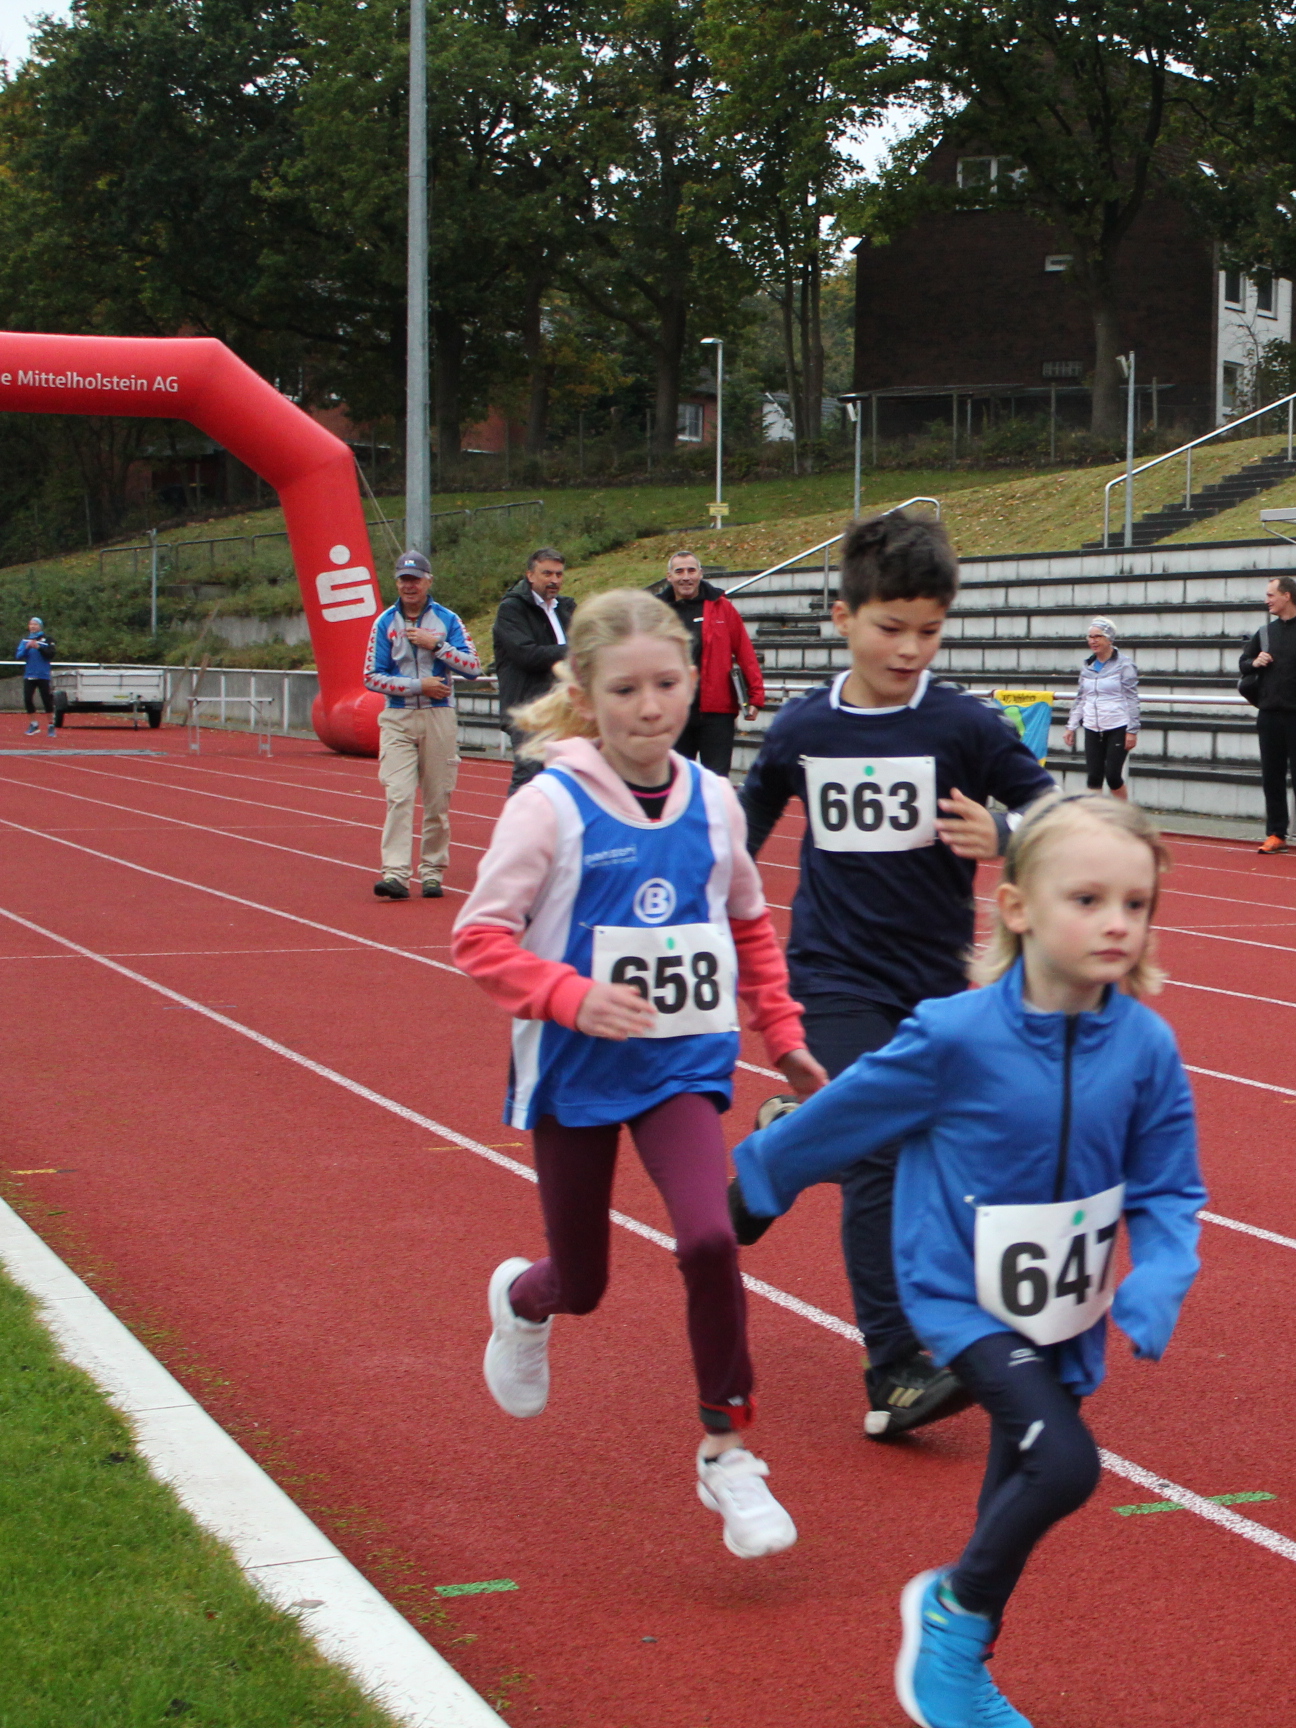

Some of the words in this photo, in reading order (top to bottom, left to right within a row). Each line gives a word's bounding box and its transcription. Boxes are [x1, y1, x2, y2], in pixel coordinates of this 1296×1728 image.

[18, 370, 148, 391] Mittelholstein
[152, 376, 178, 392] AG
[820, 781, 919, 832] 663
[644, 886, 670, 915] B
[611, 951, 720, 1015] 658
[1001, 1220, 1118, 1318] 647
